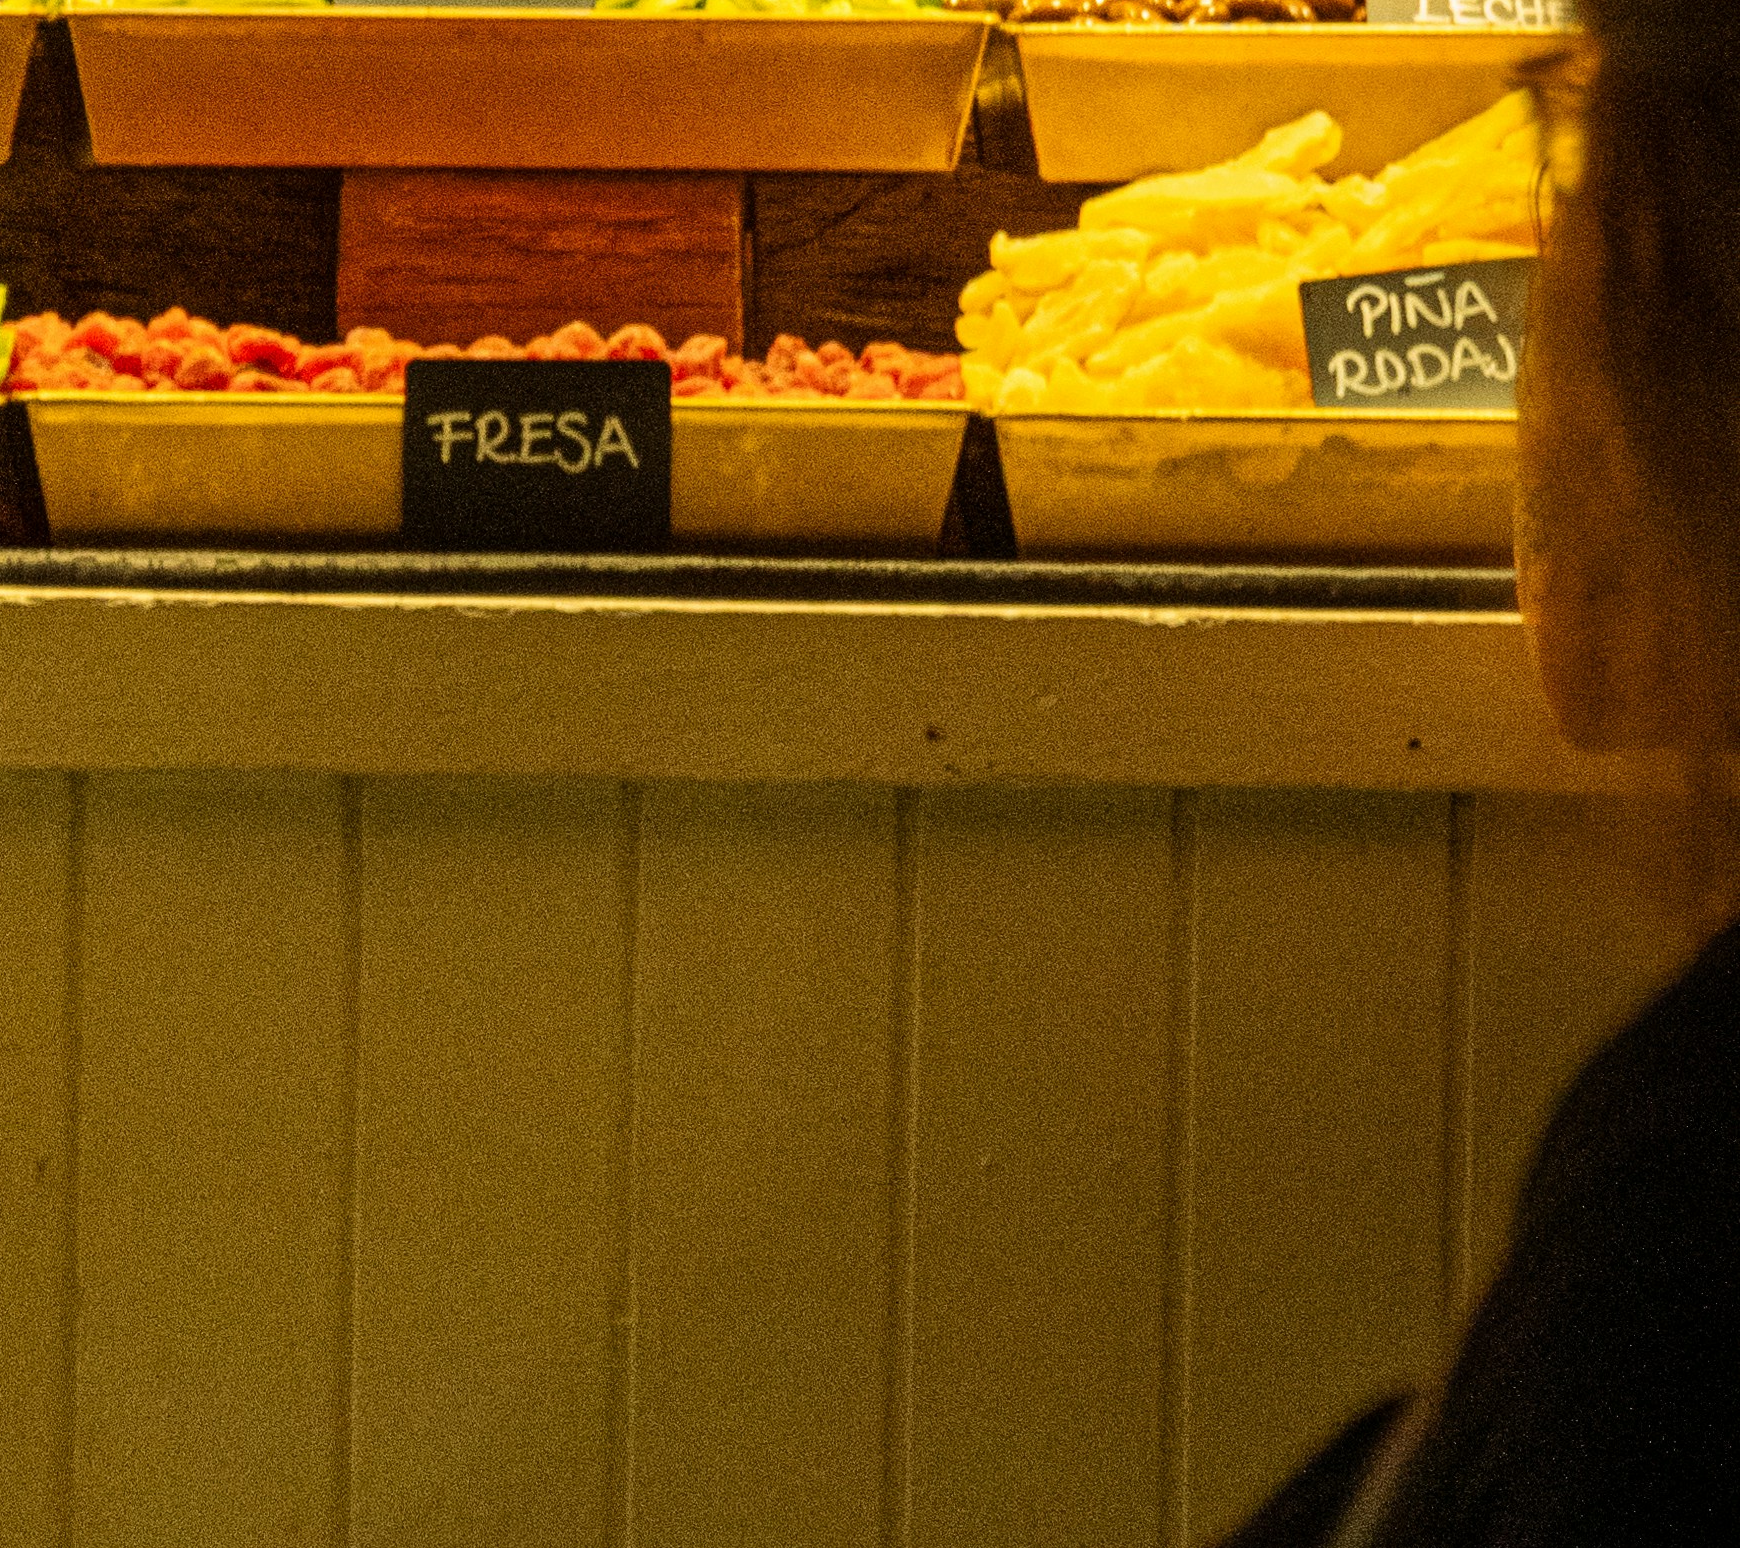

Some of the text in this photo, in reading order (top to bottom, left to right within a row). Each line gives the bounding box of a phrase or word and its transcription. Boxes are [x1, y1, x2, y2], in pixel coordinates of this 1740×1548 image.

[1346, 271, 1498, 339] PIÑA
[1328, 332, 1517, 399] RODAJ
[426, 409, 640, 474] FRESA
